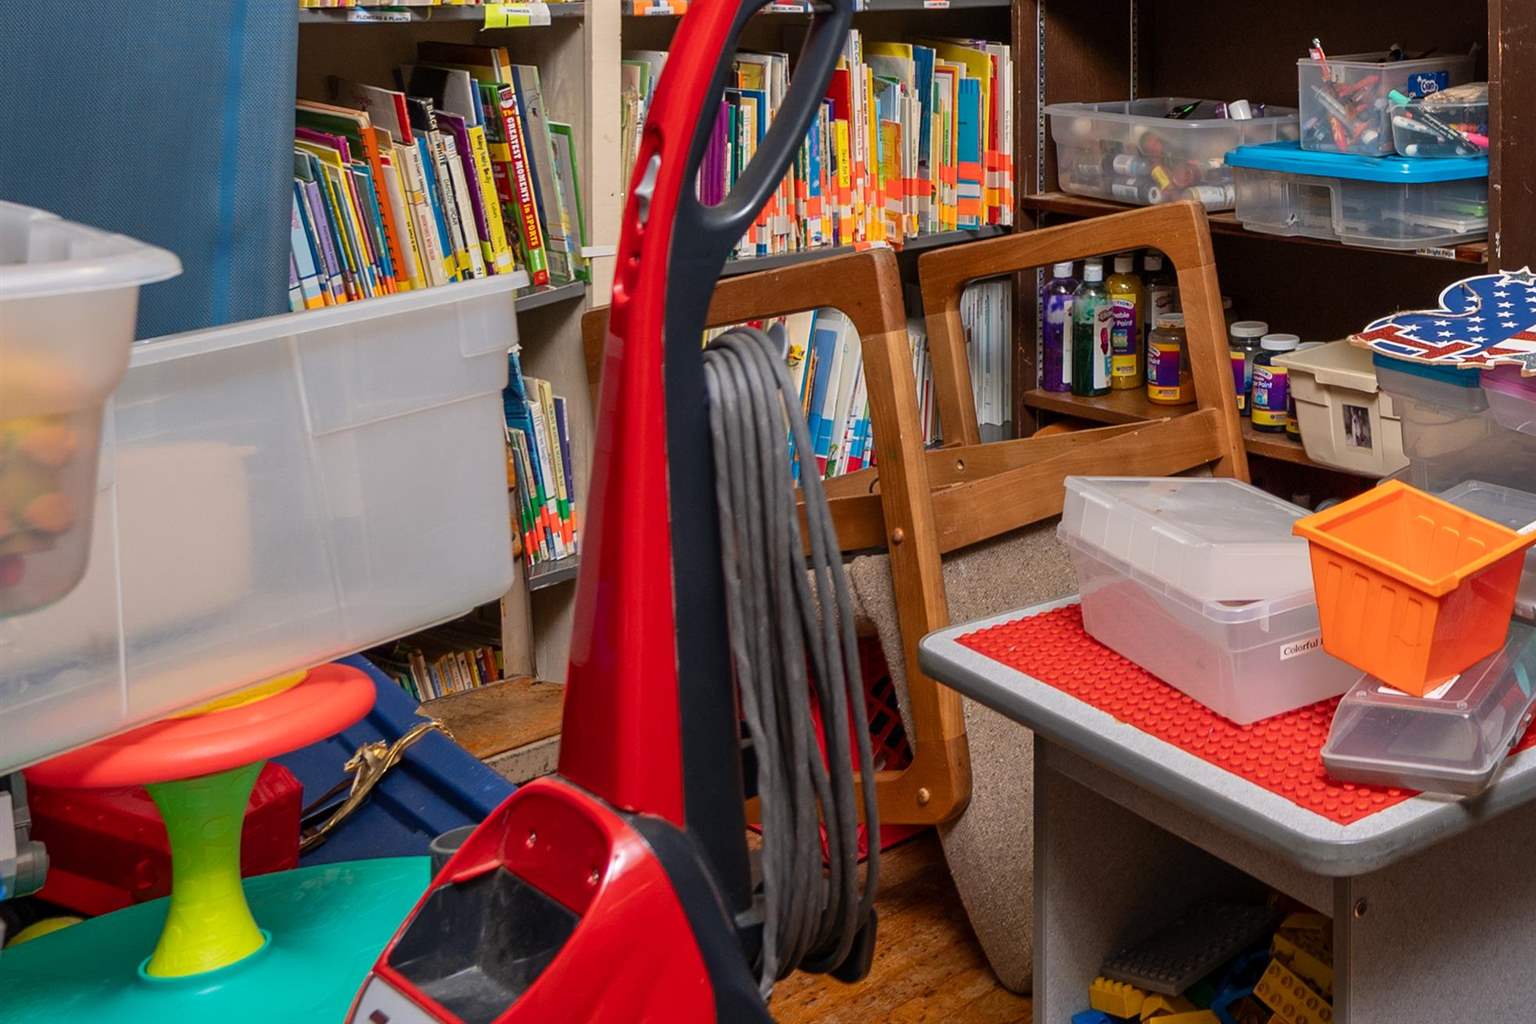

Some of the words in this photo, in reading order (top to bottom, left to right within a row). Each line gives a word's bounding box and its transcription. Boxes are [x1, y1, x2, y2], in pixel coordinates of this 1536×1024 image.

[426, 103, 437, 131] BLACK
[507, 117, 522, 160] GREATEST
[435, 141, 446, 167] WHITE
[514, 160, 530, 204] MOMENTS
[526, 215, 539, 247] SPORTS
[1284, 638, 1319, 656] Colorful
